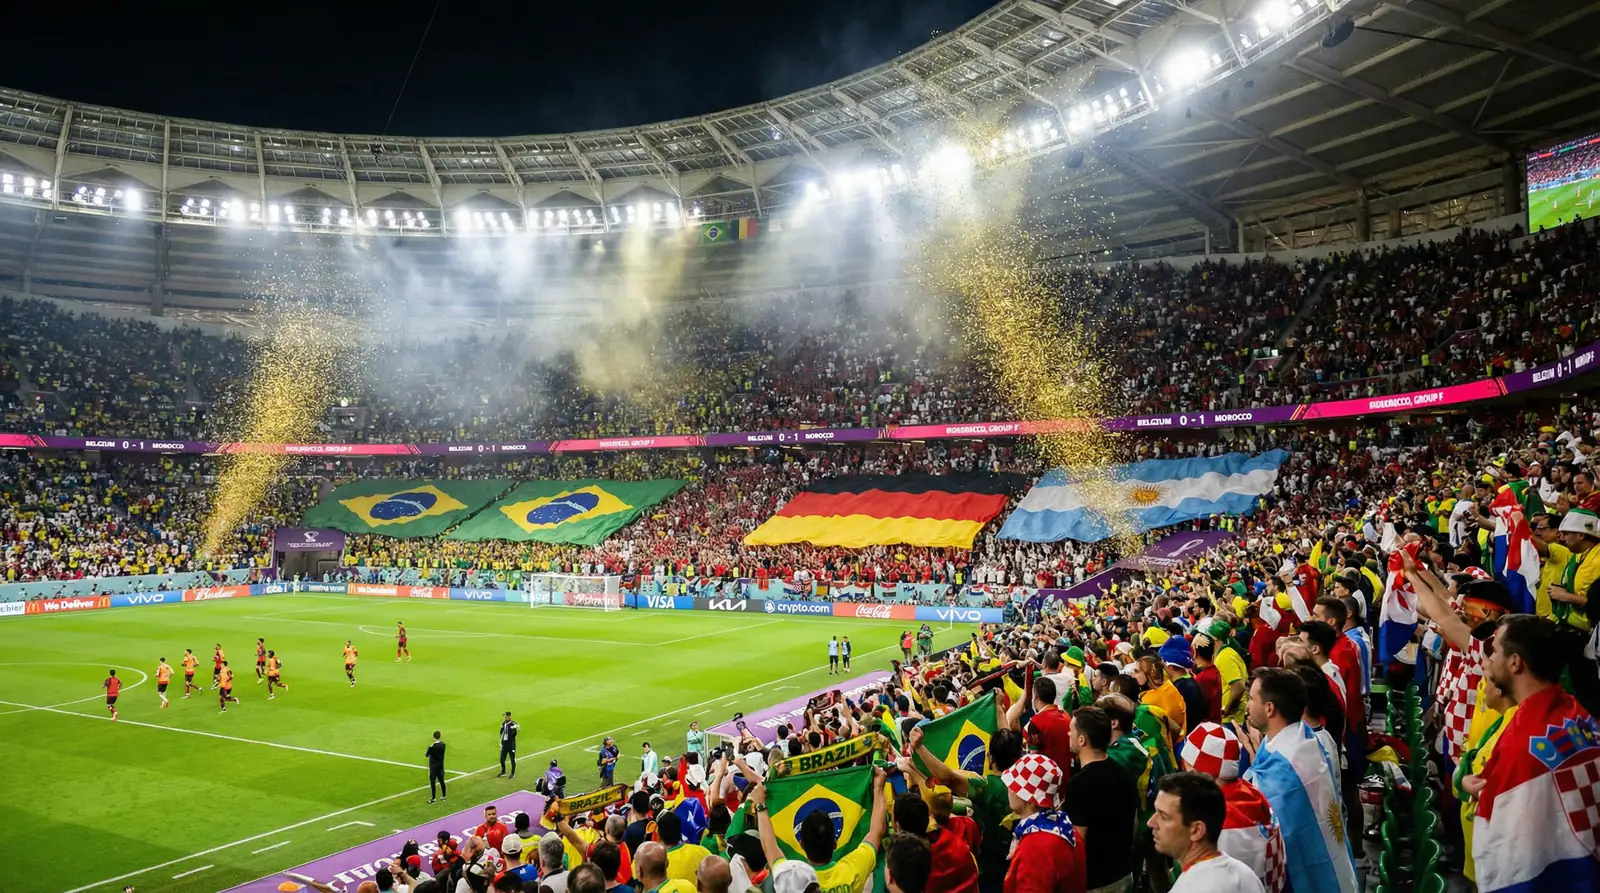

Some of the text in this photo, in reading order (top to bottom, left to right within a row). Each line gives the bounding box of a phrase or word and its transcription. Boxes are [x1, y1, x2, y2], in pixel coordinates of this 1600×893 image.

[1414, 393, 1438, 404] GROUP
[1439, 391, 1444, 401] F
[1138, 418, 1171, 426] BELGIUM
[1180, 416, 1187, 425] 0
[1200, 415, 1204, 424] 1
[1215, 413, 1252, 421] MOROCCO
[779, 433, 784, 441] 0
[794, 433, 797, 441] 1
[44, 602, 59, 610] We
[647, 595, 675, 609] VISA
[778, 602, 829, 613] crypto.com
[800, 743, 859, 772] BRAZIL
[570, 793, 612, 811] BRAZIL
